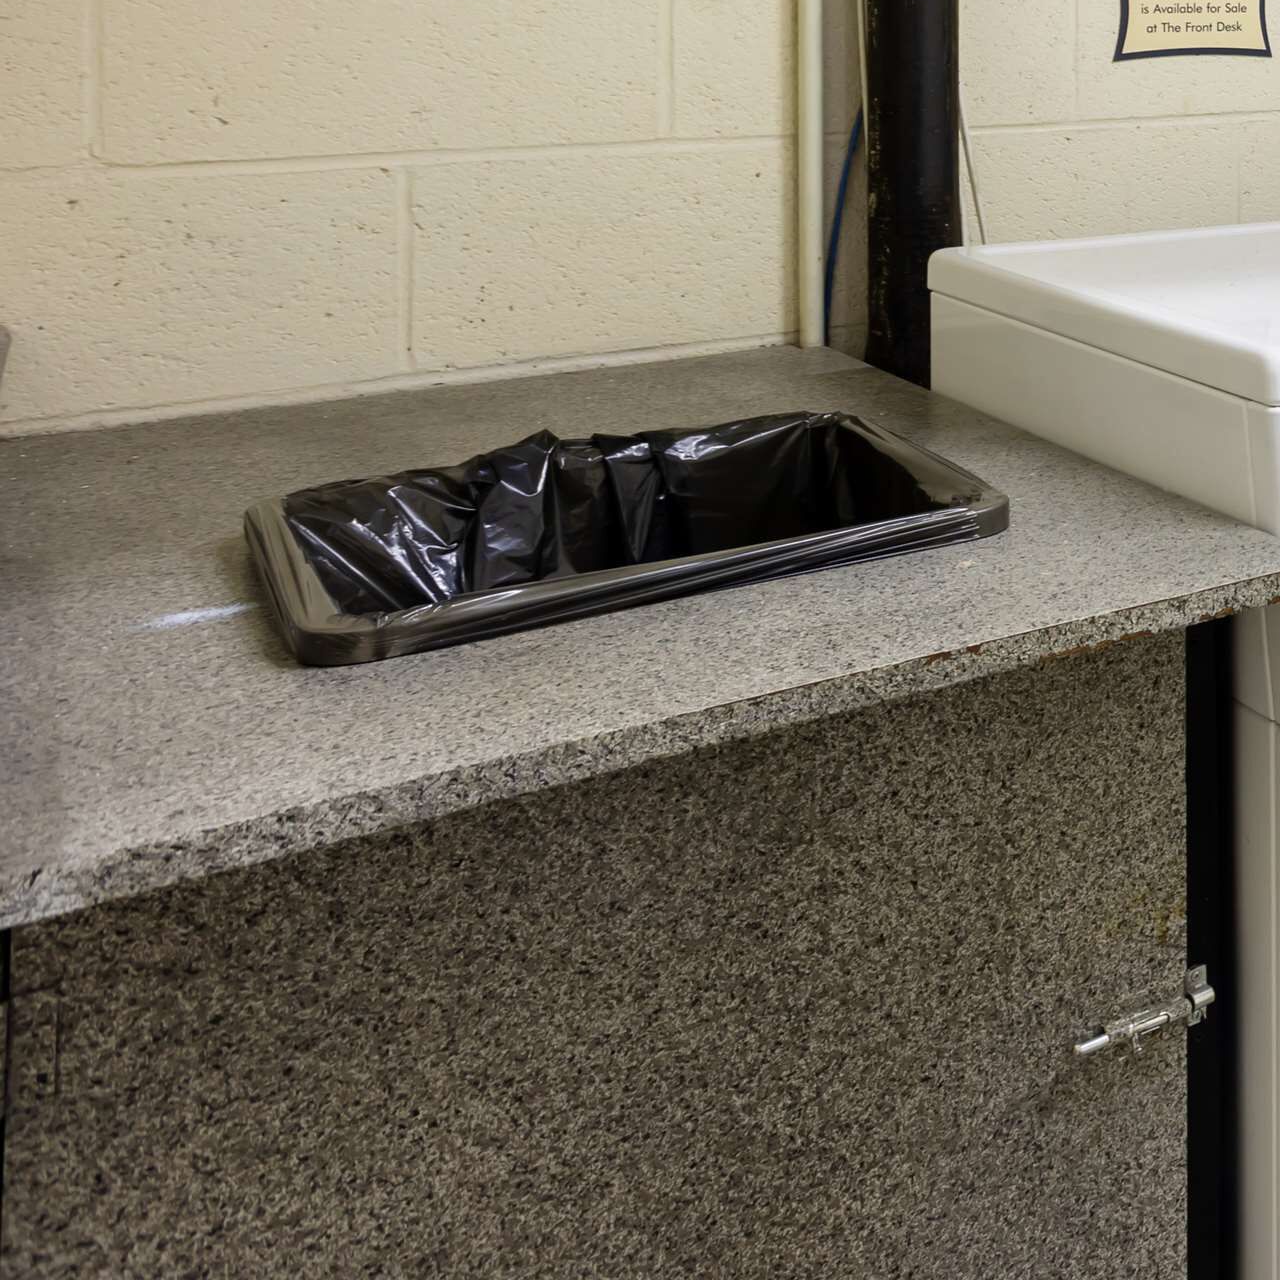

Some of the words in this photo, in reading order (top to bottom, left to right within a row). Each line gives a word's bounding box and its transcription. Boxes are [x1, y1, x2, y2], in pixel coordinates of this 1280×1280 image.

[1141, 4, 1149, 14] is
[1153, 3, 1202, 15] Available
[1207, 3, 1221, 13] for
[1225, 2, 1247, 13] Sale
[1146, 24, 1157, 33] at
[1161, 22, 1181, 33] The
[1185, 22, 1213, 32] Front
[1216, 21, 1242, 32] Desk
